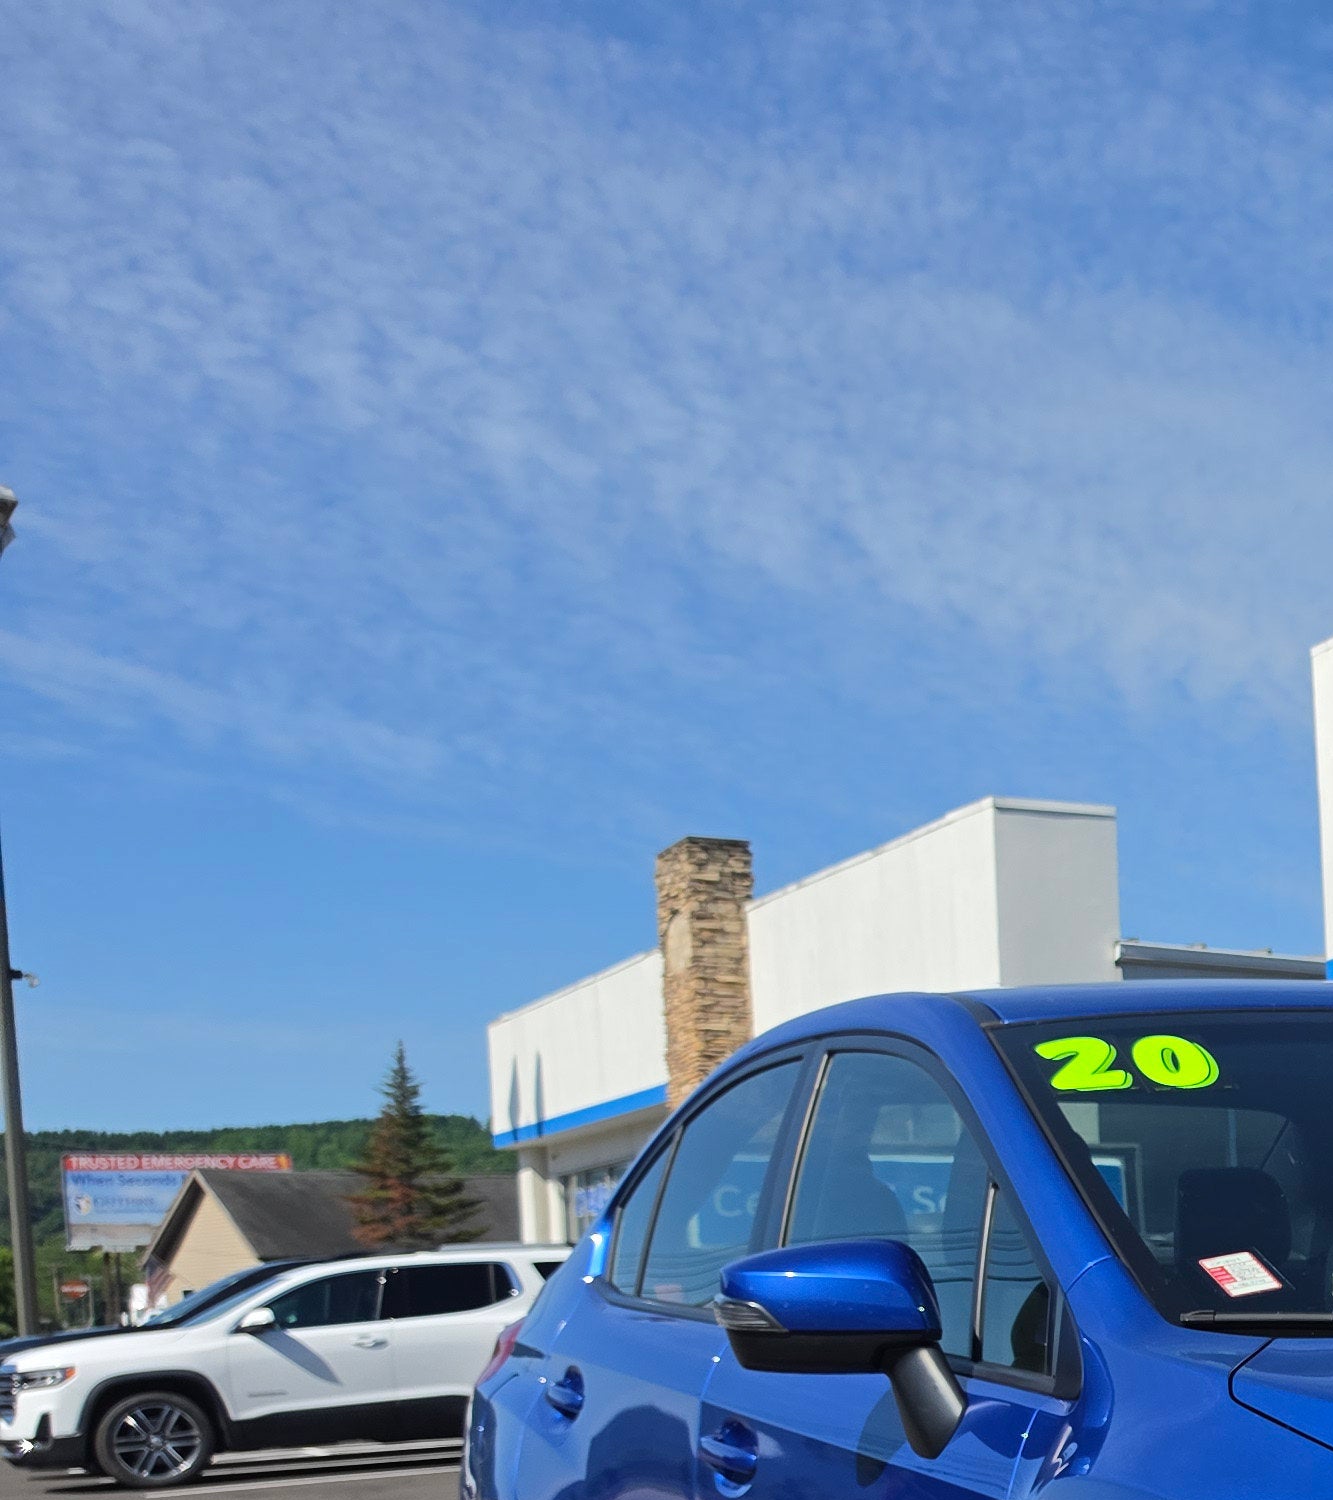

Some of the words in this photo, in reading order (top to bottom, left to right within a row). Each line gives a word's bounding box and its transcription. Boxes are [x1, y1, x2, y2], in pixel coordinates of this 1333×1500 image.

[1034, 1035, 1220, 1092] 20
[69, 1156, 139, 1170] TRUSTED
[142, 1156, 236, 1170] EMERGENCY
[238, 1156, 277, 1170] CARE
